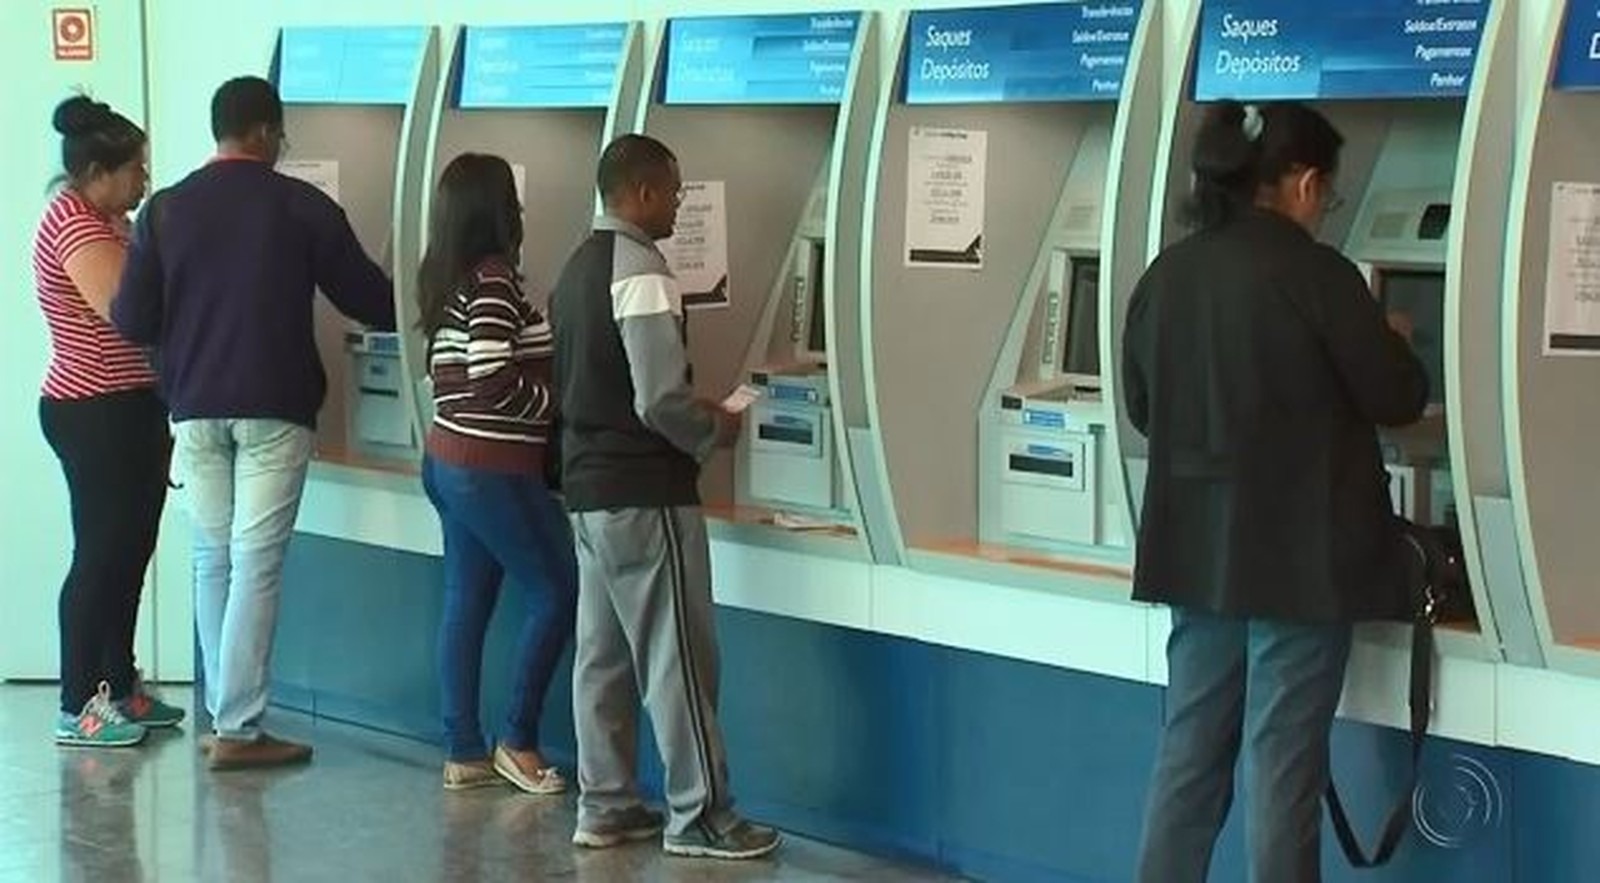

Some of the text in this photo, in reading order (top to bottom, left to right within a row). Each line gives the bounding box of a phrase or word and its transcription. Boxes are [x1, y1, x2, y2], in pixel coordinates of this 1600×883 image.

[926, 24, 973, 53] Saques
[1221, 13, 1278, 45] Saques
[920, 58, 990, 85] Depósitos
[1216, 49, 1302, 80] Depósitos
